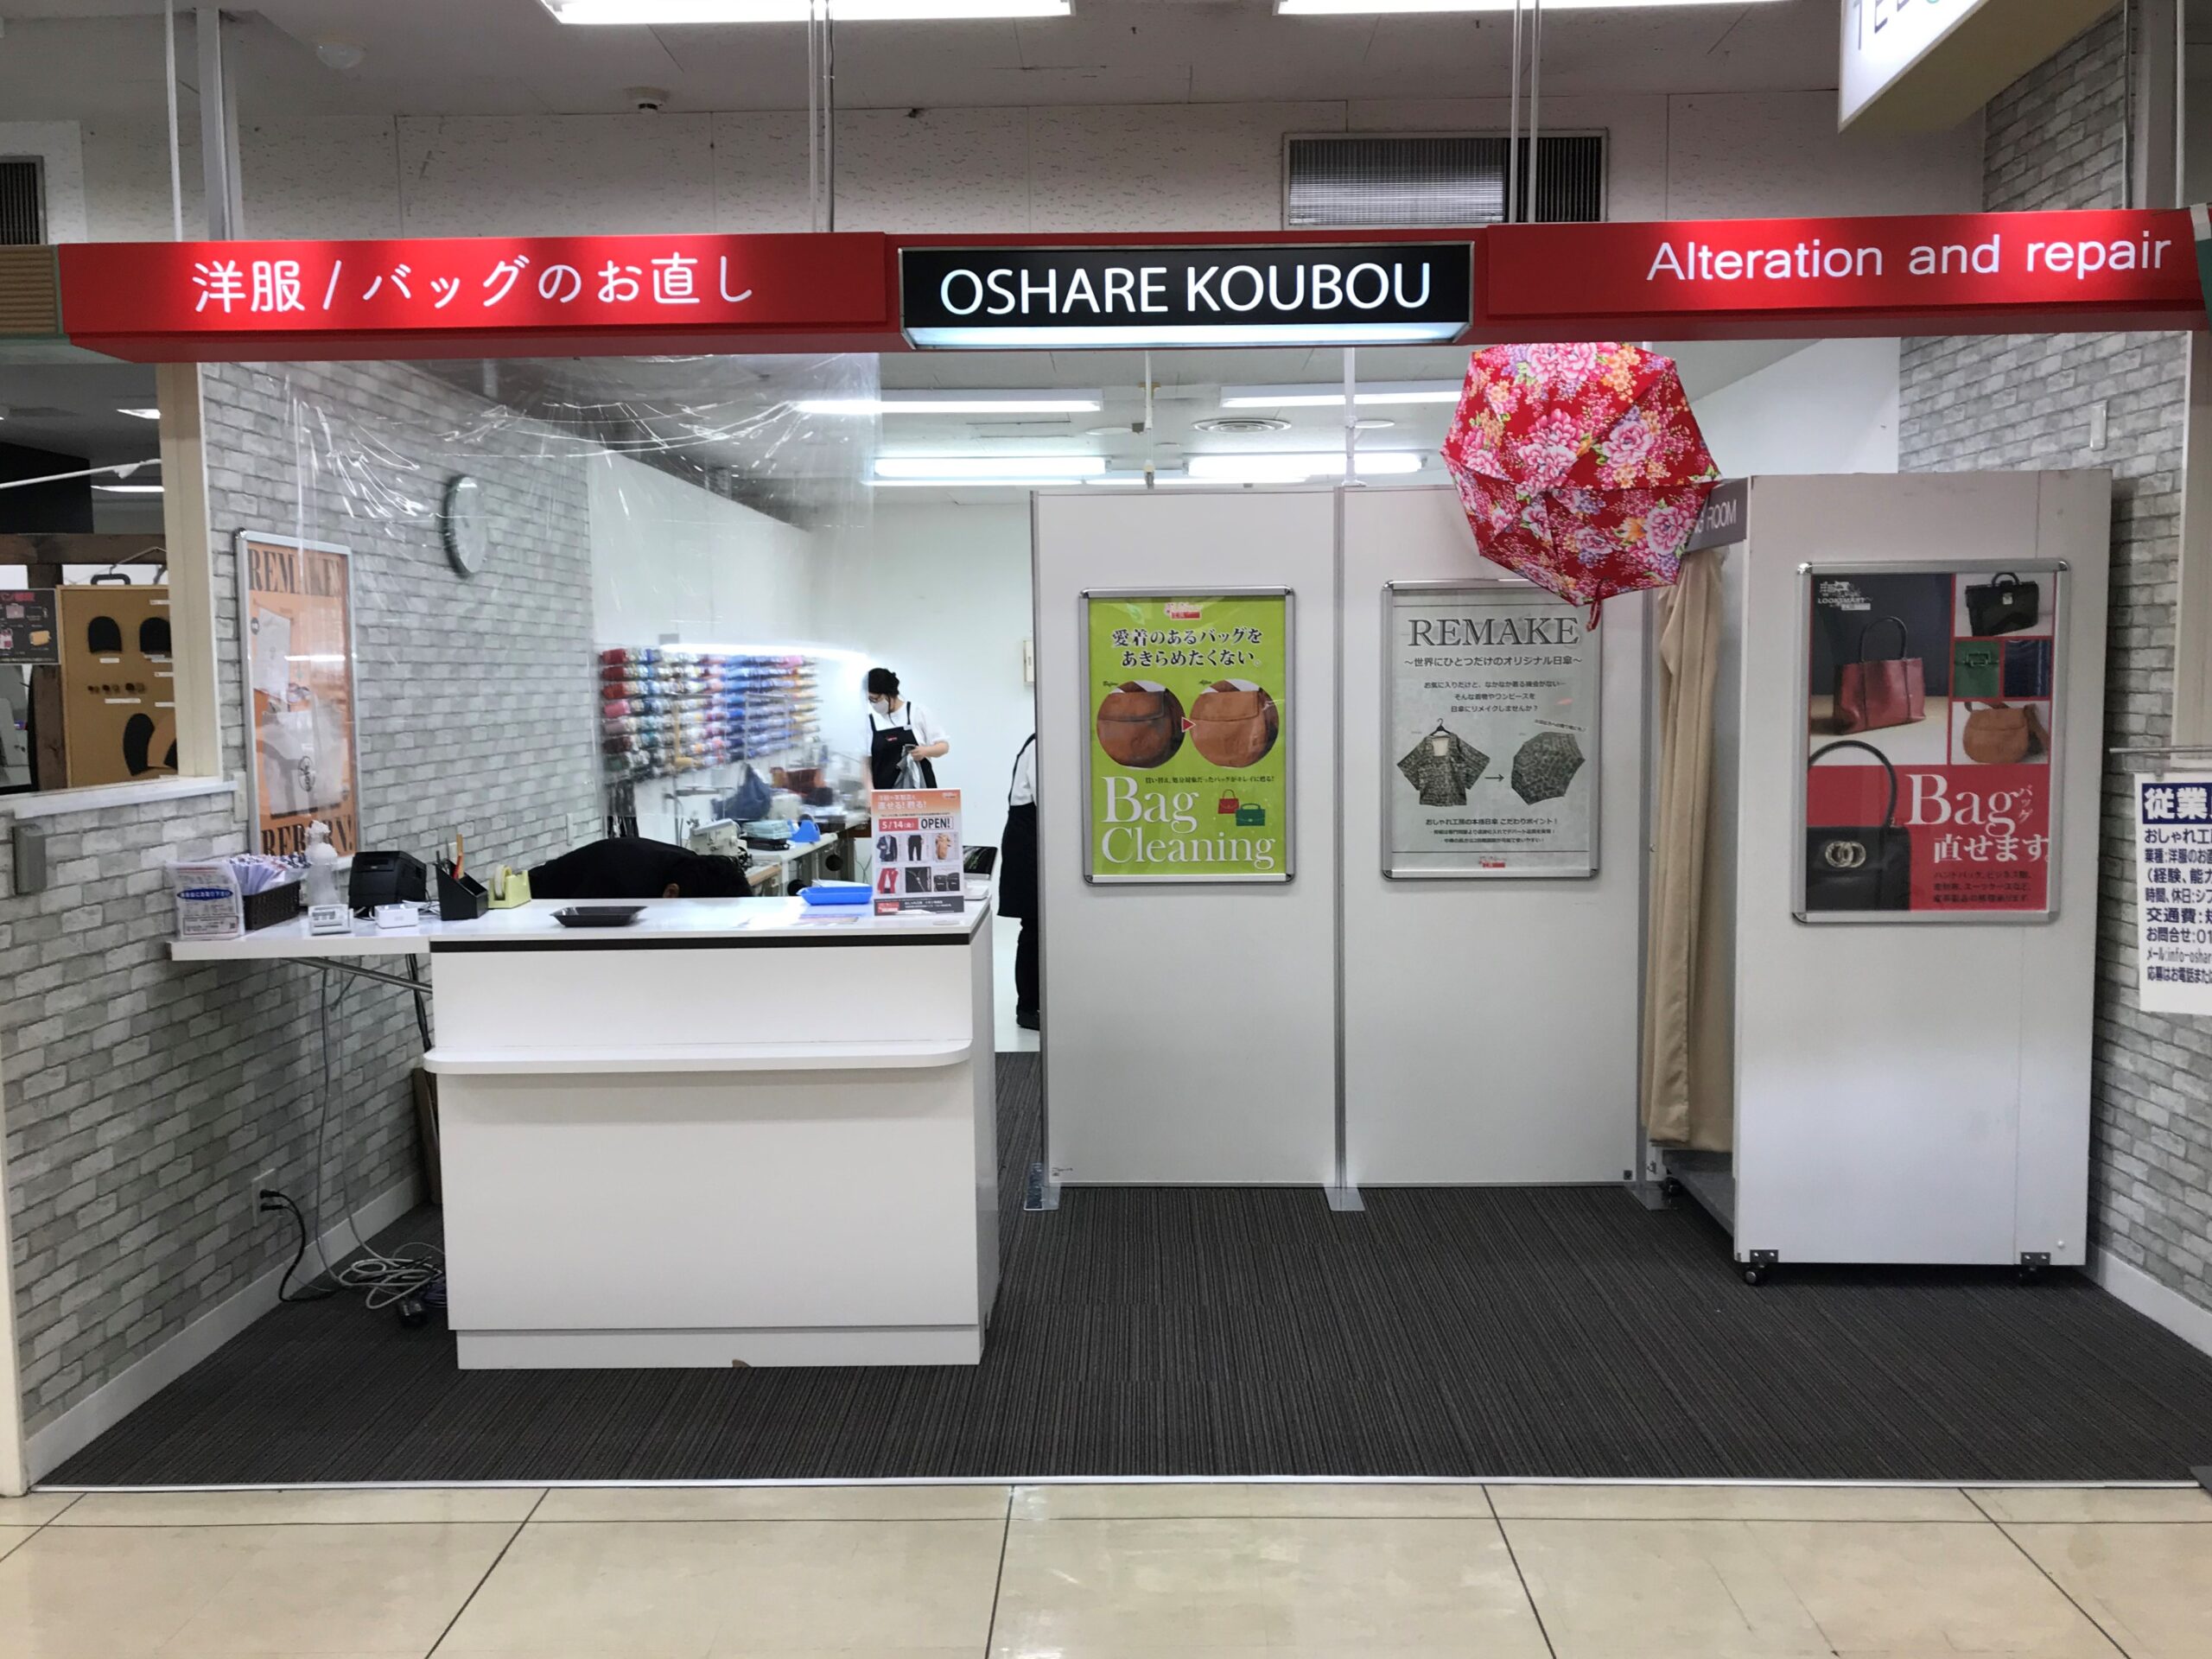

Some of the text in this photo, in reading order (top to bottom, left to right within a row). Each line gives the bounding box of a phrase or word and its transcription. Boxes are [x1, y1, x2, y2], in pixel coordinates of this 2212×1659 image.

[1647, 230, 2171, 281] Alteration and repair
[940, 262, 1430, 315] OSHARE KOUBOU
[1112, 627, 1262, 647] 愛着のあるバッグを
[1408, 617, 1580, 647] REMAKE
[1122, 649, 1262, 668] あきらめたくない。
[1102, 776, 1199, 834] Bag
[1904, 773, 2020, 838] Bag
[2018, 784, 2034, 823] バッグ
[2144, 786, 2212, 820] 従業
[261, 814, 353, 858] REBRN!
[920, 817, 950, 830] OPEN!
[2145, 828, 2212, 844] おしゃれ工
[1102, 827, 1276, 871] Cleaning
